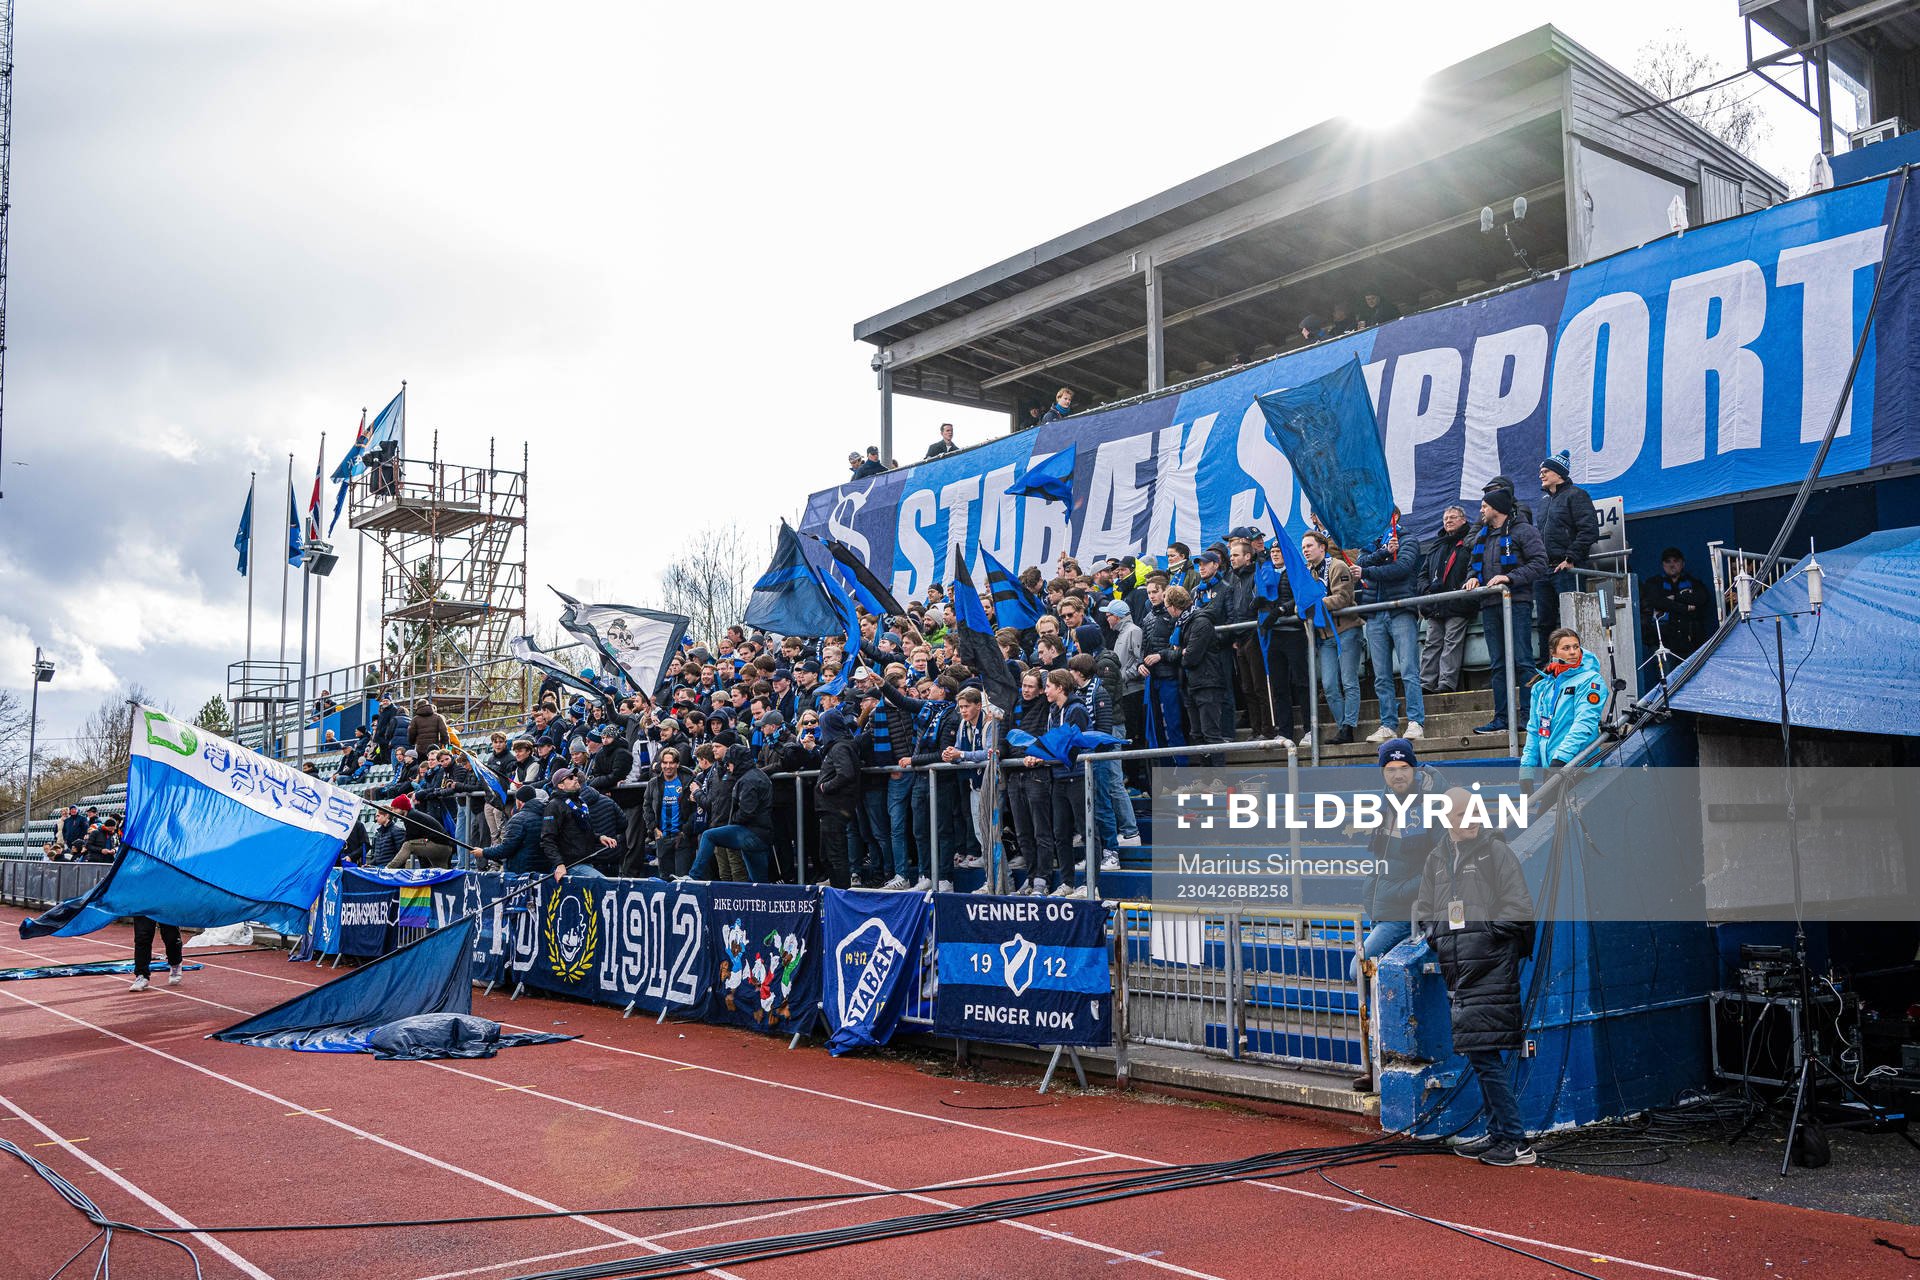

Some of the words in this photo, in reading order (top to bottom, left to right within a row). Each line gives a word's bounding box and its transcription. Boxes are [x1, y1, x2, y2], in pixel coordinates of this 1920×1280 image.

[893, 412, 1219, 598] STABÆK
[1229, 225, 1889, 541] SPPORT
[733, 899, 767, 912] GUTTER
[768, 901, 796, 913] LEKER
[966, 903, 1040, 922] VENNER
[1045, 903, 1074, 921] OG
[599, 890, 702, 1005] 1912
[970, 953, 992, 973] 19
[1043, 957, 1067, 978] 12
[848, 937, 894, 1025] STABÆK
[964, 1004, 1030, 1025] PENGER
[1035, 1011, 1074, 1030] NOK
